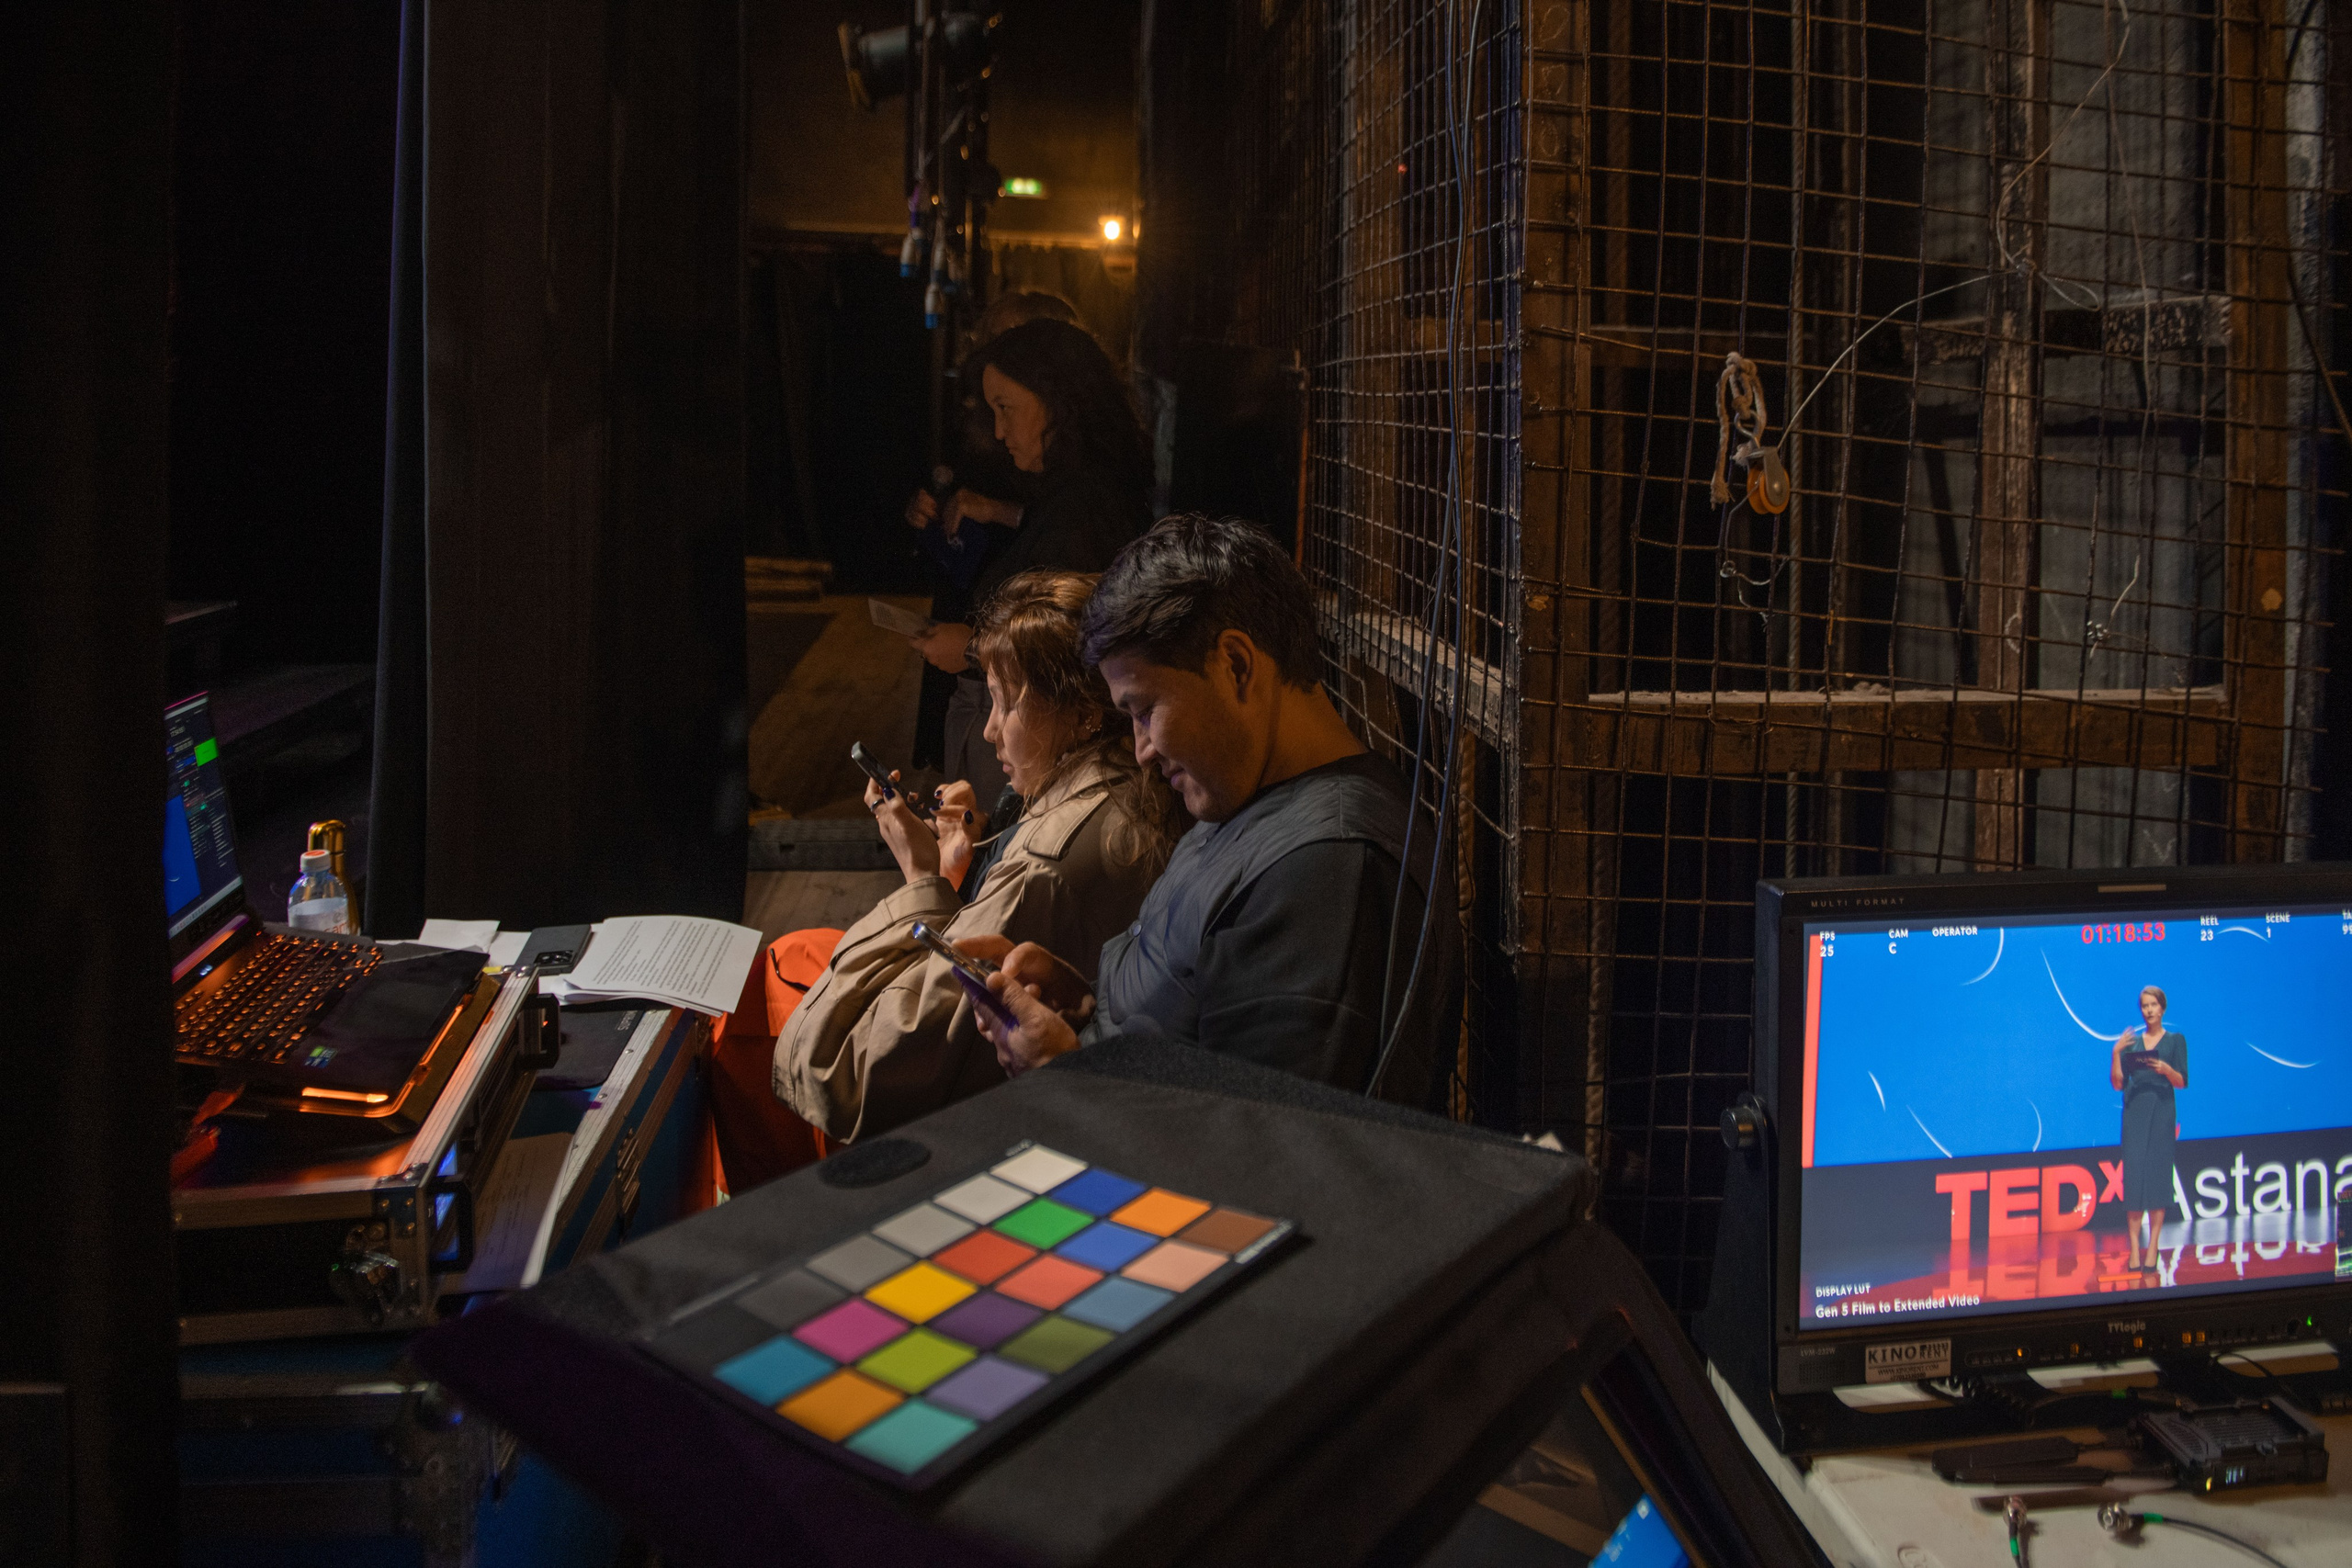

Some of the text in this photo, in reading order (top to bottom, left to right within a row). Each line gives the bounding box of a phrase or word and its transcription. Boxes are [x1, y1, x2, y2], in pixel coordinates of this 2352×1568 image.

[1811, 897, 1905, 908] MULTI FORMAT
[2199, 915, 2220, 926] REEL
[2265, 912, 2290, 923] SCENE
[1819, 931, 1836, 942] FPS
[1888, 928, 1908, 939] CAM
[1931, 925, 1978, 937] OPERATOR
[2081, 922, 2165, 943] 01:18:53
[2199, 930, 2214, 942] 23
[2266, 926, 2271, 938] 1
[1819, 944, 1835, 957] 25
[1888, 942, 1897, 954] C
[1815, 1282, 1871, 1298] DISPLAY LUT
[1815, 1293, 1980, 1319] Gen 5 Film to Extended Video
[1868, 1346, 1917, 1364] KINO
